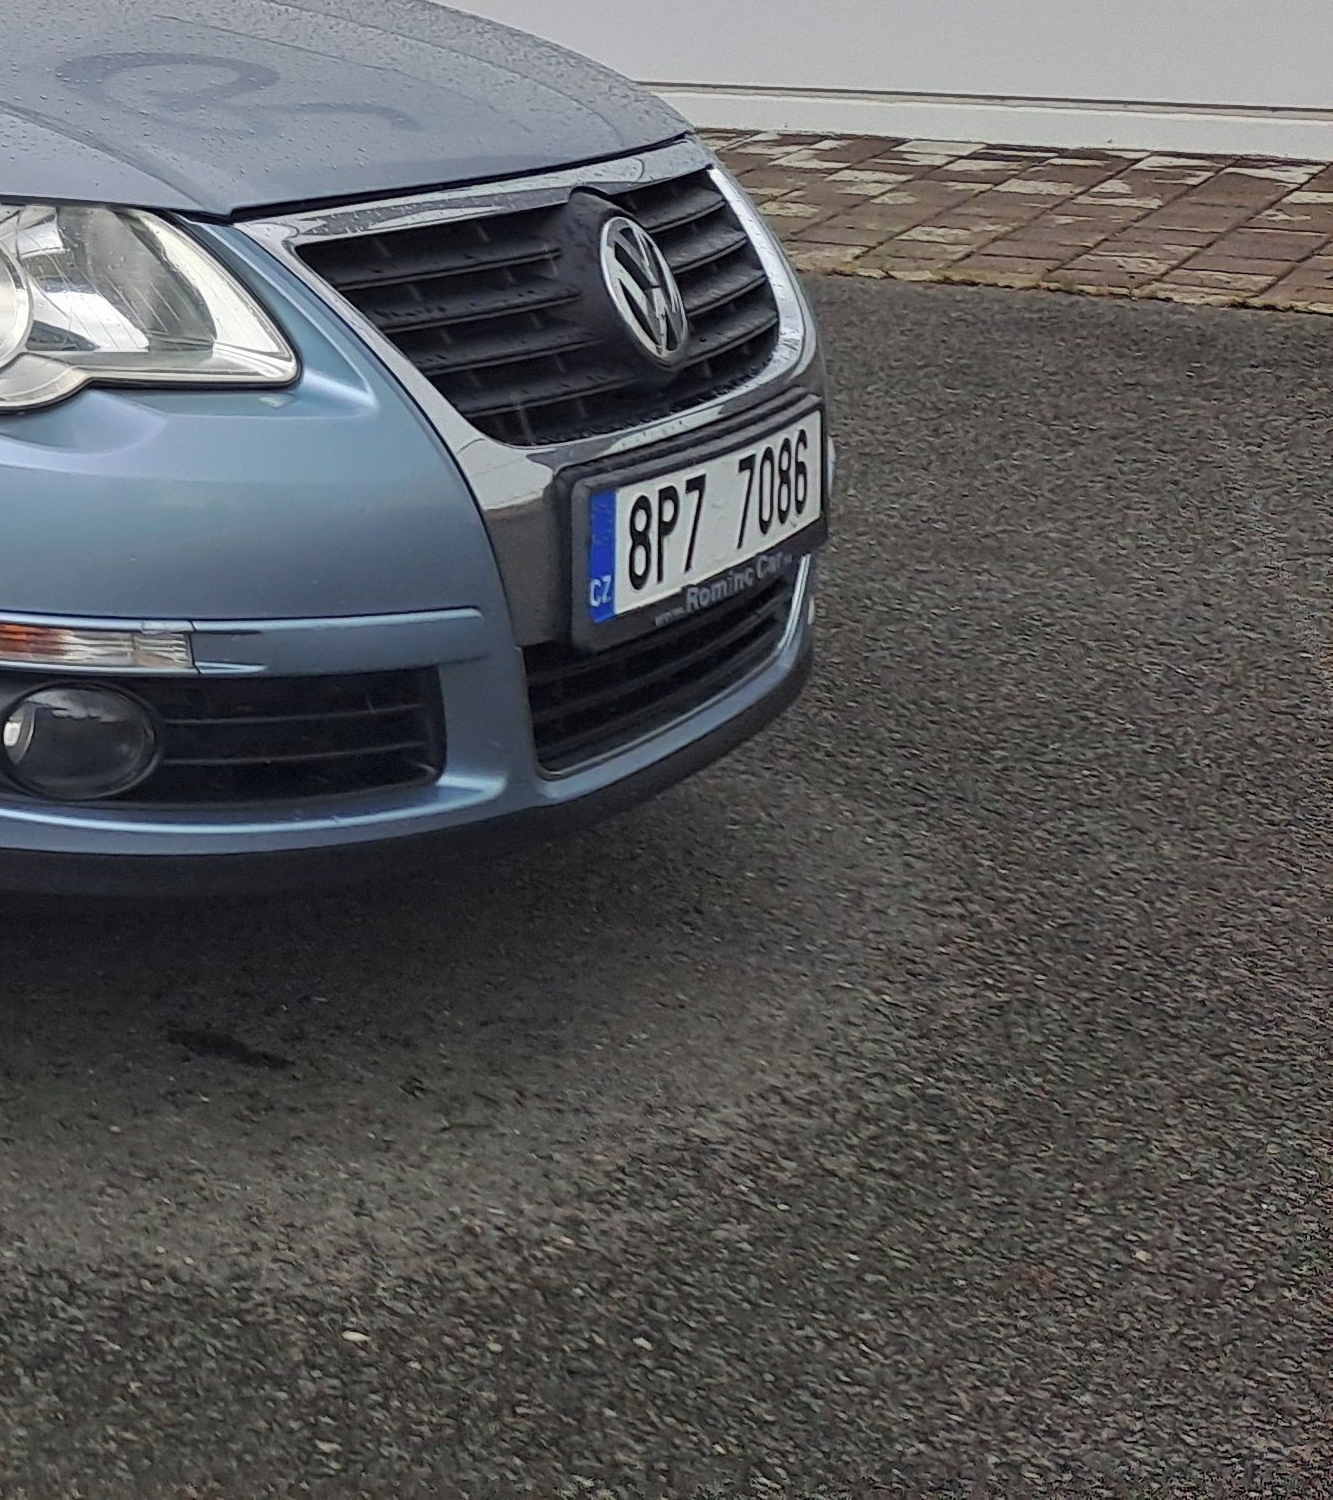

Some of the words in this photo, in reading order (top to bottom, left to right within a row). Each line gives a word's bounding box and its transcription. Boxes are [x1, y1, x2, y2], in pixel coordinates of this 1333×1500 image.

[628, 473, 707, 591] 8P7
[737, 428, 808, 550] 7086
[590, 574, 612, 607] CZ
